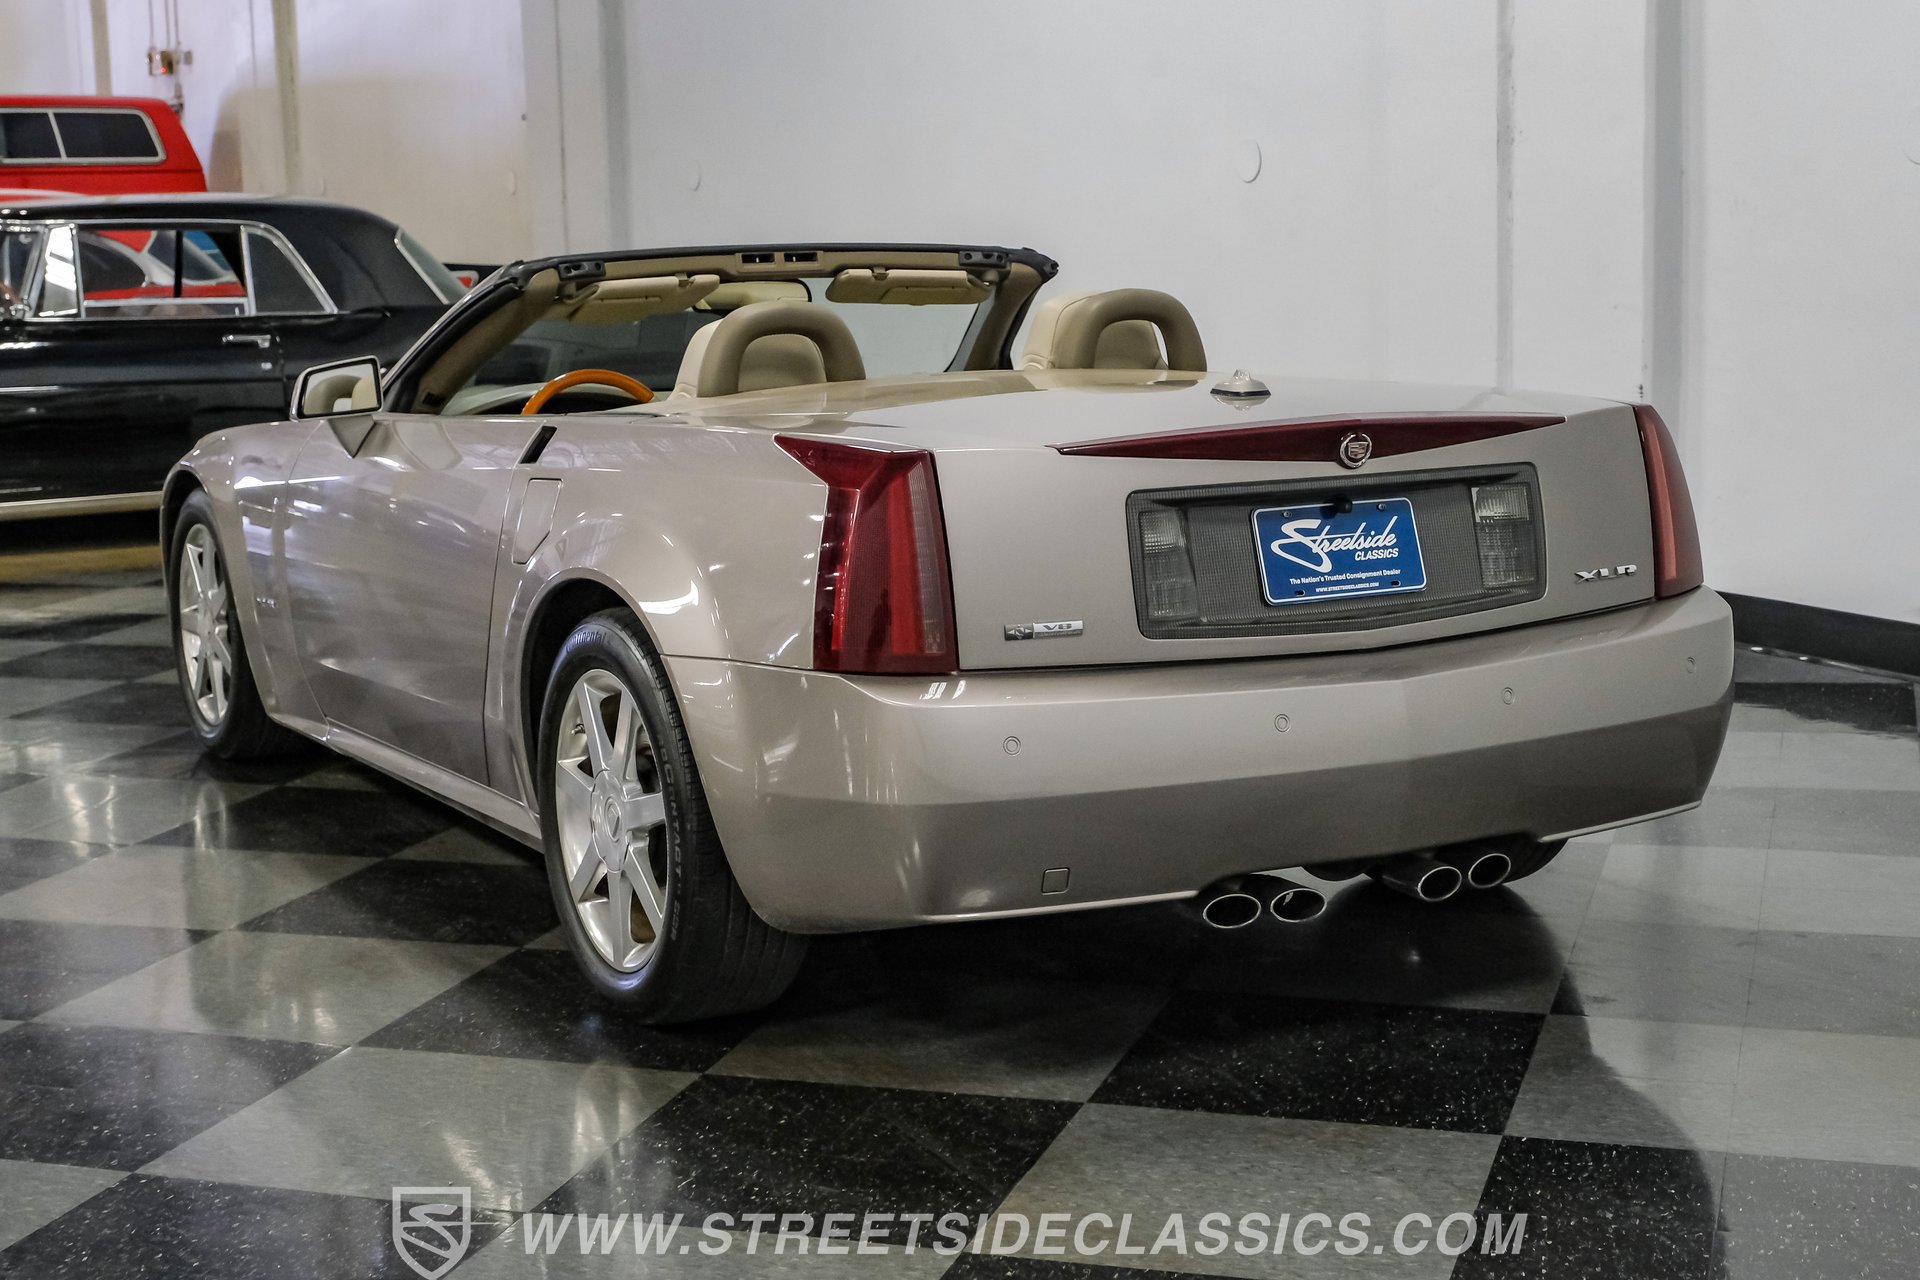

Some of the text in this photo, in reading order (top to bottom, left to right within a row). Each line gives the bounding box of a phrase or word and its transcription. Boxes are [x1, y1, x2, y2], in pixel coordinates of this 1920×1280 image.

[1271, 515, 1398, 573] Streetside
[1355, 548, 1398, 561] CLASSICS
[1289, 568, 1401, 586] The Nation's Trusted Consignment Dealer
[1042, 623, 1072, 631] V8
